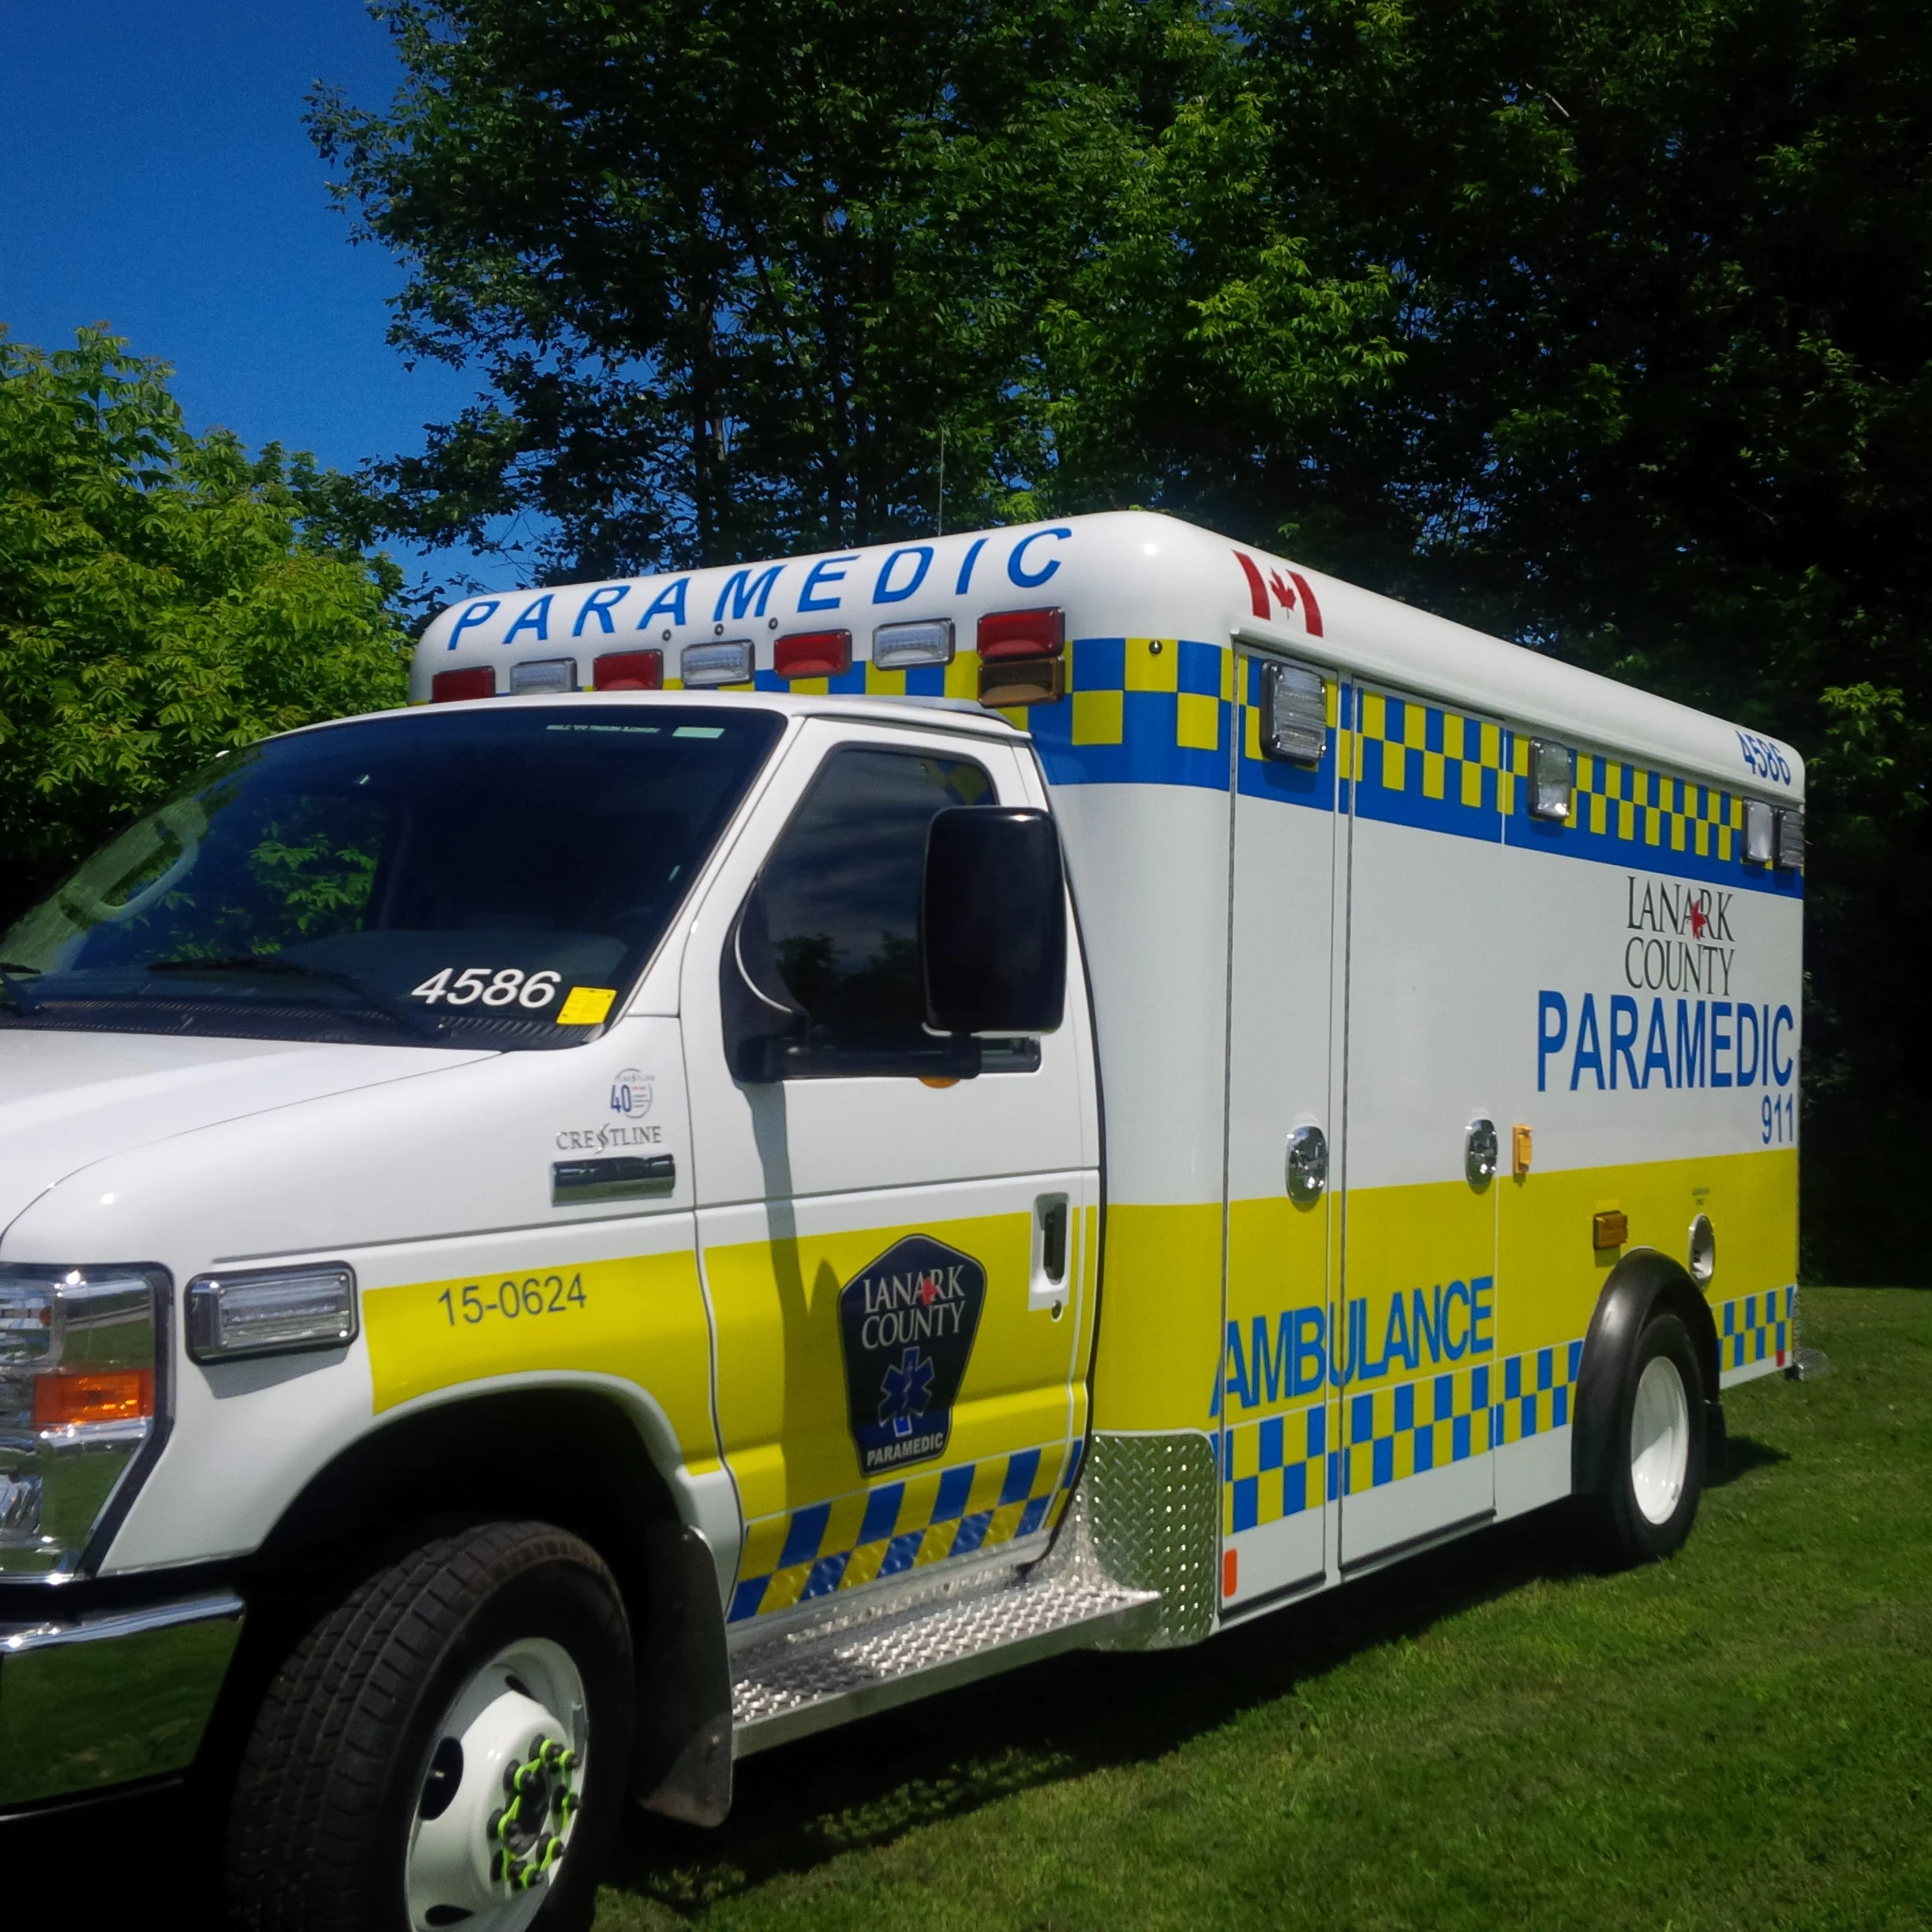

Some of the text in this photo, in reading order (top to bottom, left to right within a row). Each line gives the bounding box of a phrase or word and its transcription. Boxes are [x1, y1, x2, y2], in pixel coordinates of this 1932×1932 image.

[447, 527, 1072, 650] PARAMEDIC
[1735, 730, 1792, 785] 4586
[1626, 875, 1735, 942] LANARK
[411, 968, 562, 1009] 4586
[1624, 936, 1735, 996] COUNTY
[1537, 989, 1794, 1092] PARAMEDIC
[609, 1084, 632, 1113] 40
[1761, 1093, 1794, 1145] 911
[556, 1122, 662, 1154] CRESTLINE
[437, 1272, 587, 1327] 15-0624
[863, 1264, 966, 1314] LANARK
[861, 1300, 966, 1350] COUNTY
[1209, 1275, 1493, 1418] AMBULANCE
[867, 1432, 944, 1466] PARAMEDIC
